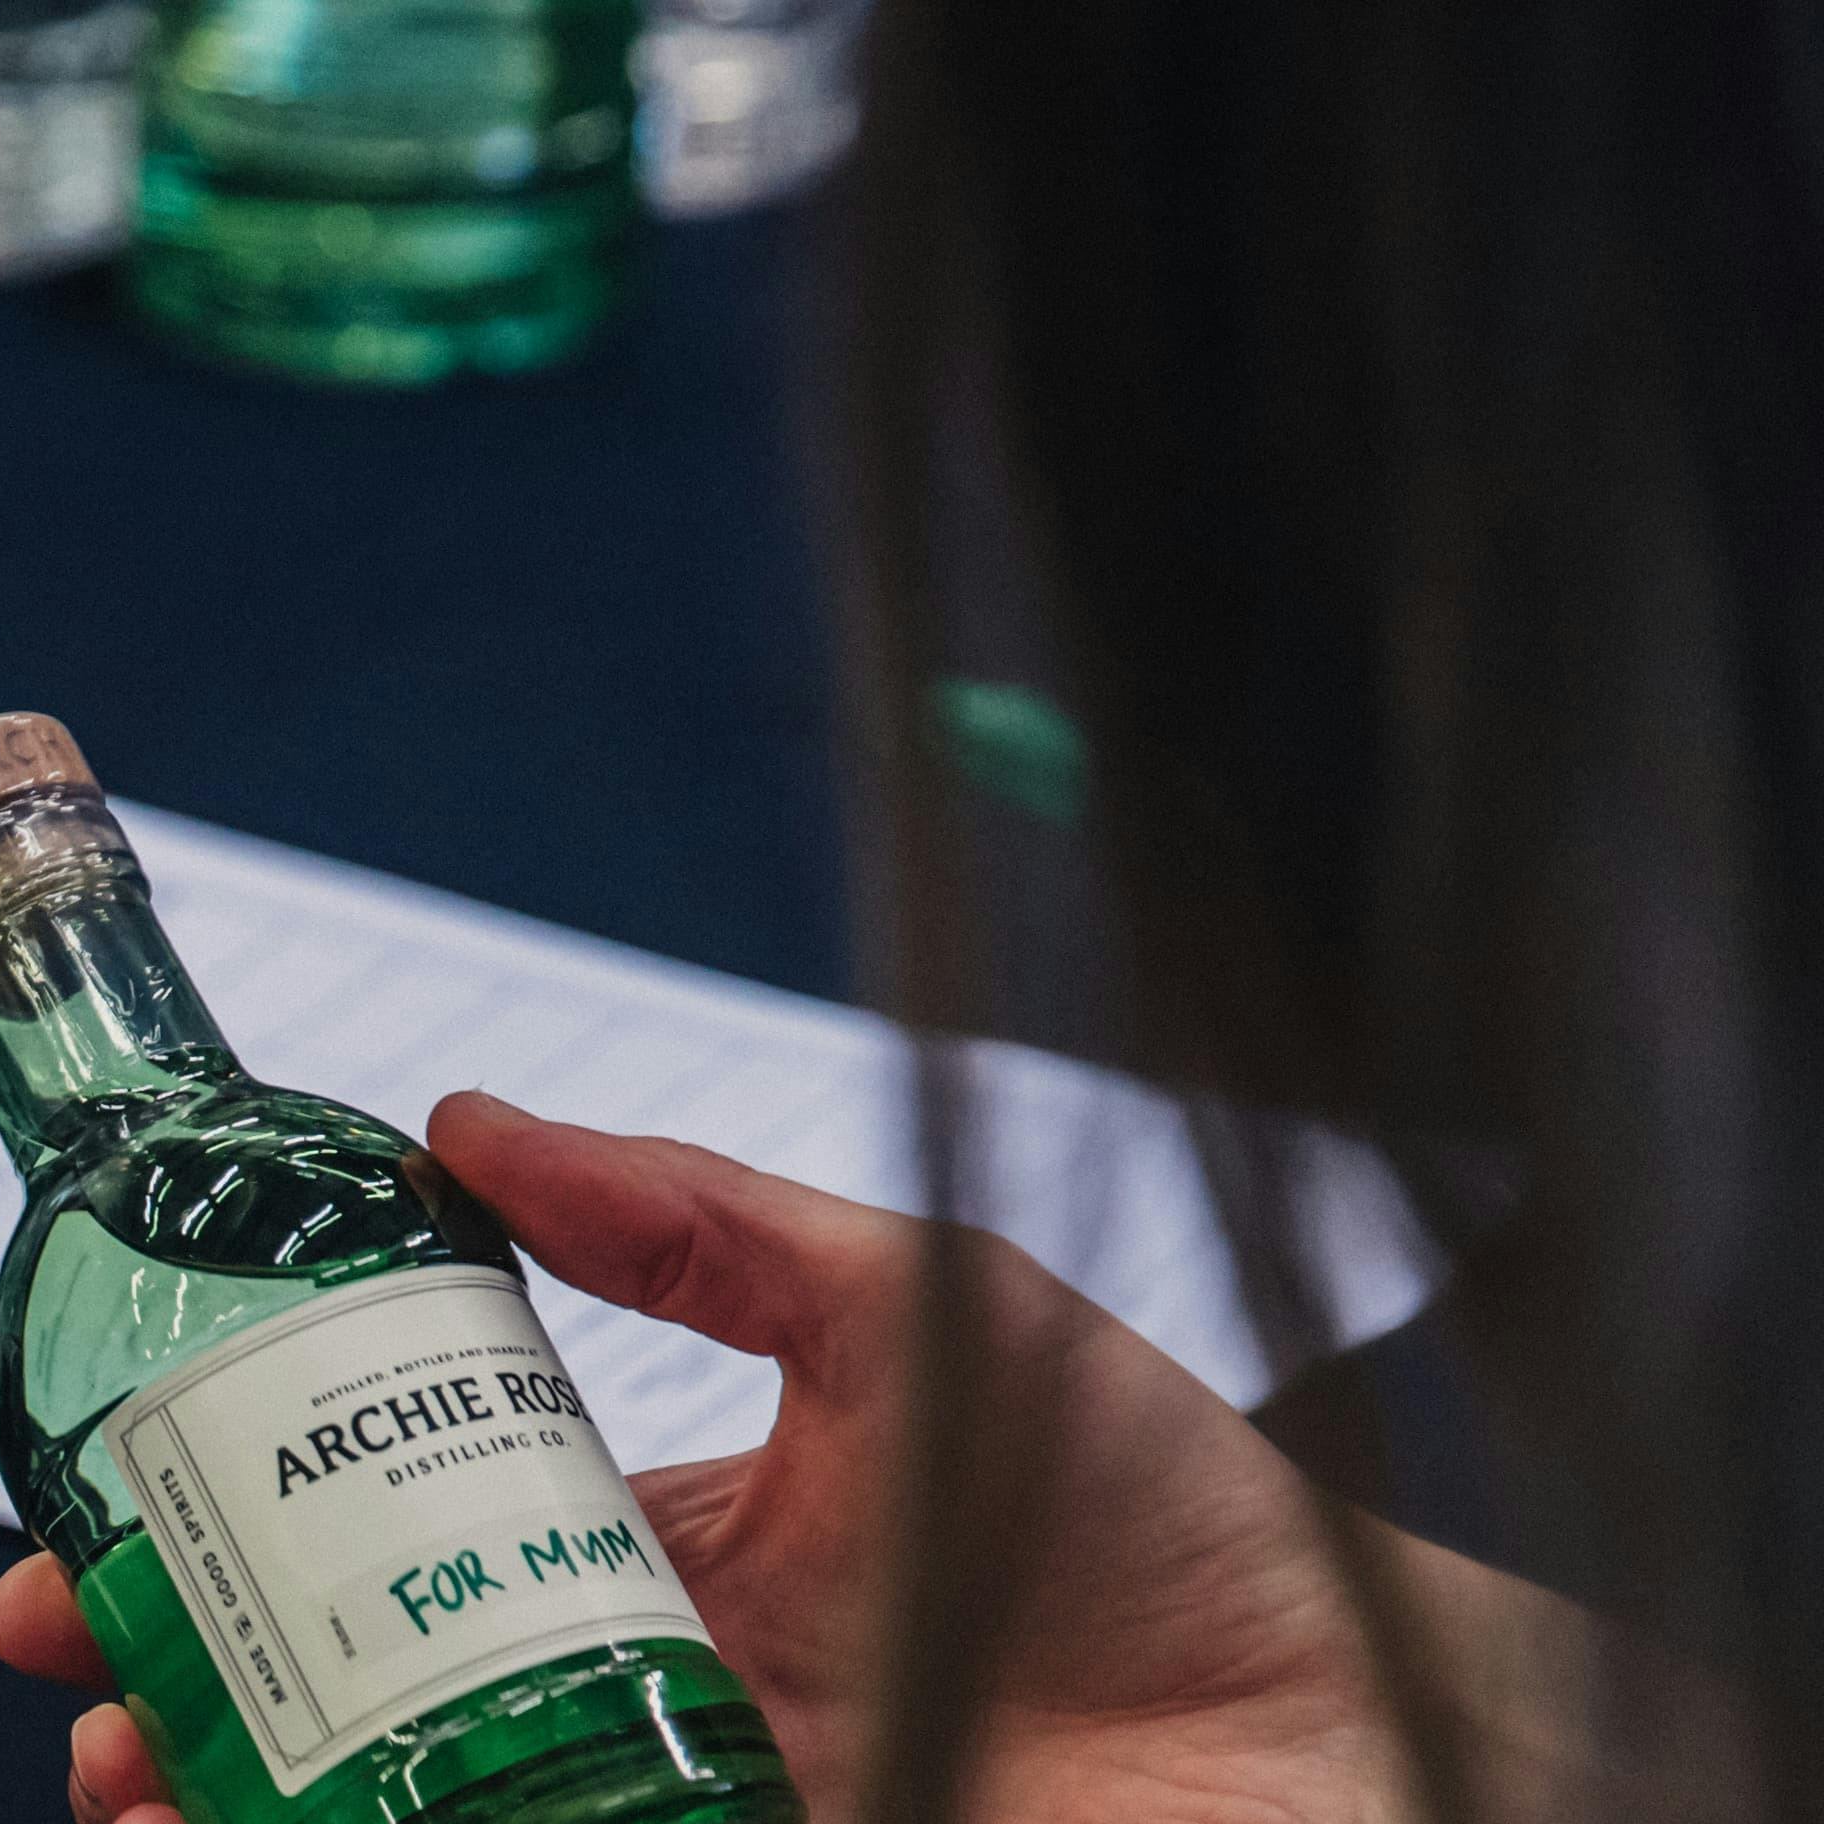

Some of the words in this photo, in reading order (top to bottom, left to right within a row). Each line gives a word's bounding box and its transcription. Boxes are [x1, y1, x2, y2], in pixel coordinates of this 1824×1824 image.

[394, 1353, 454, 1376] BOTTLED
[458, 1346, 484, 1361] AND
[274, 1376, 494, 1500] ARCHIE
[385, 1432, 532, 1487] DISTILLING
[539, 1429, 572, 1449] CO.
[159, 1466, 206, 1545] SPIRITS
[202, 1550, 239, 1609] GOOD
[388, 1548, 506, 1636] FOR
[518, 1518, 656, 1585] MUM
[248, 1643, 289, 1706] MADE
